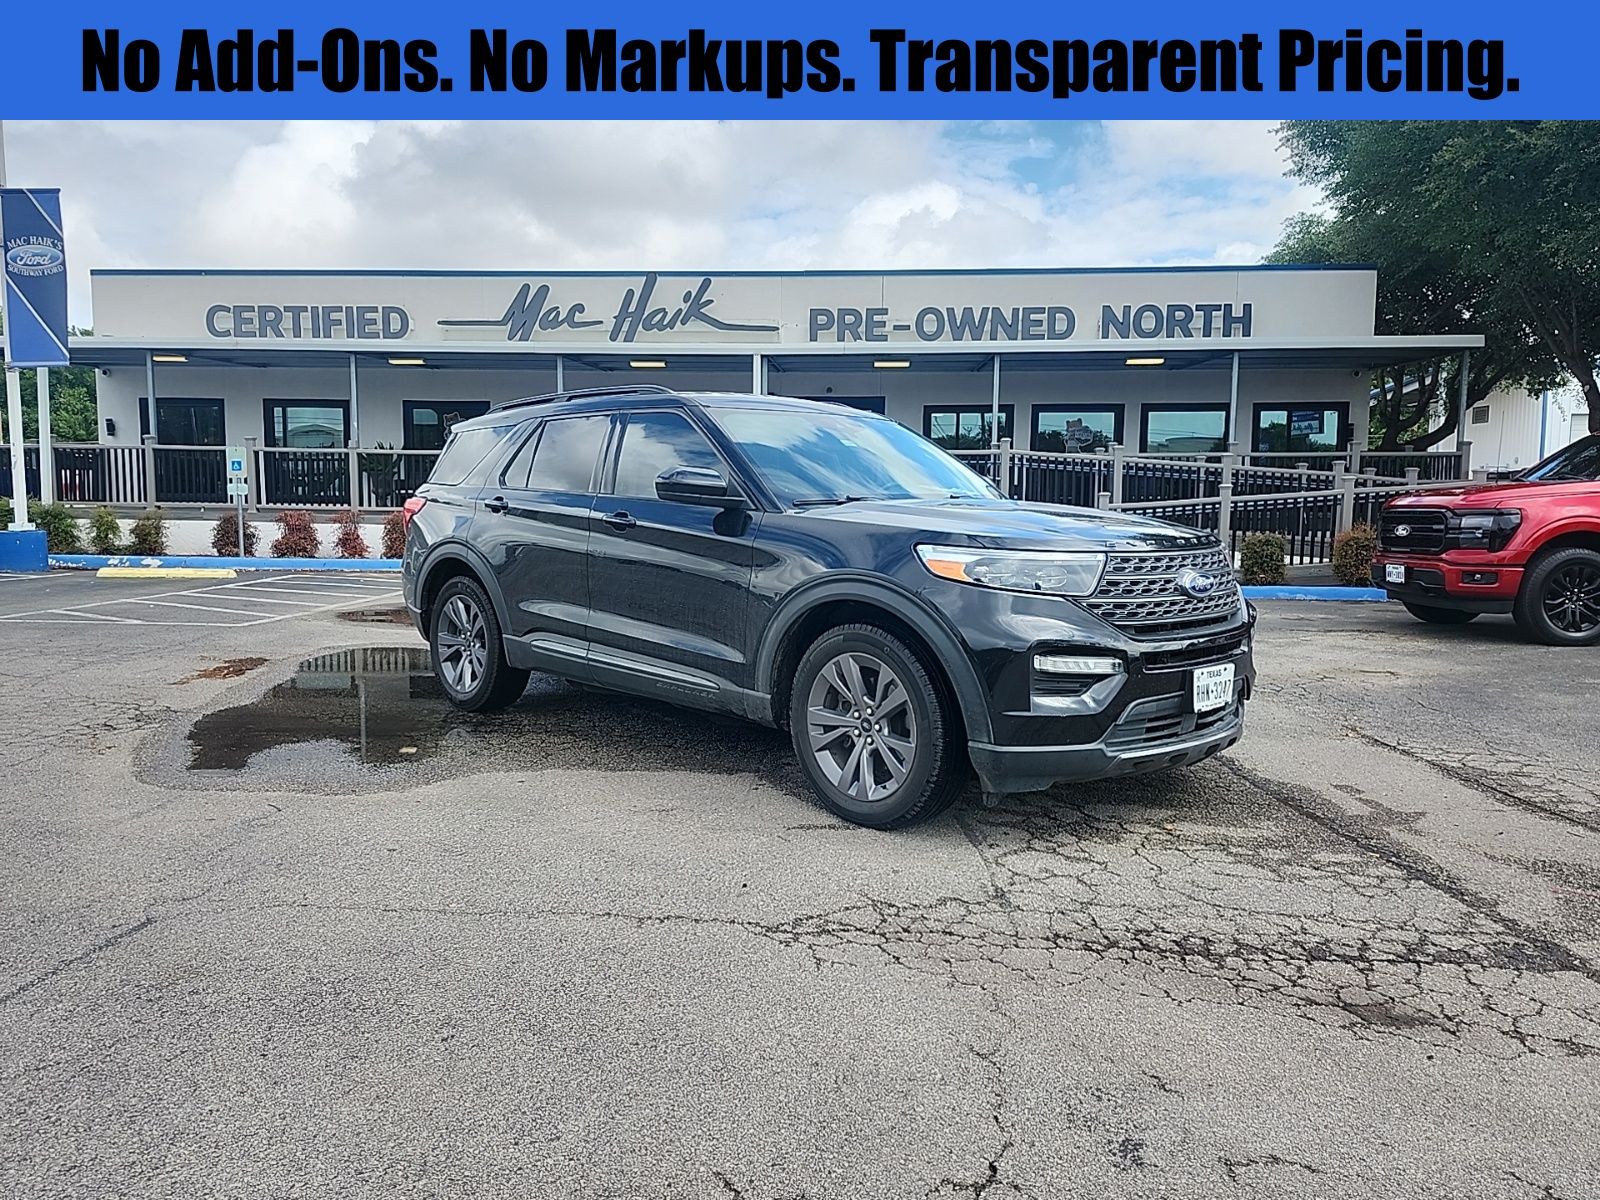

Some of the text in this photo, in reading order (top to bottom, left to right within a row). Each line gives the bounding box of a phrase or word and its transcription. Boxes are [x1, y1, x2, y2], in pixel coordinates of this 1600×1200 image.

[6, 235, 63, 250] MAC HAIK'S
[16, 249, 52, 265] Ford
[7, 264, 64, 277] SOUTHWAY FORD
[437, 271, 780, 343] Mac Haik
[205, 303, 1253, 342] CERTIFIED PRE-OWNED NORTH
[1206, 669, 1222, 679] TEXAS
